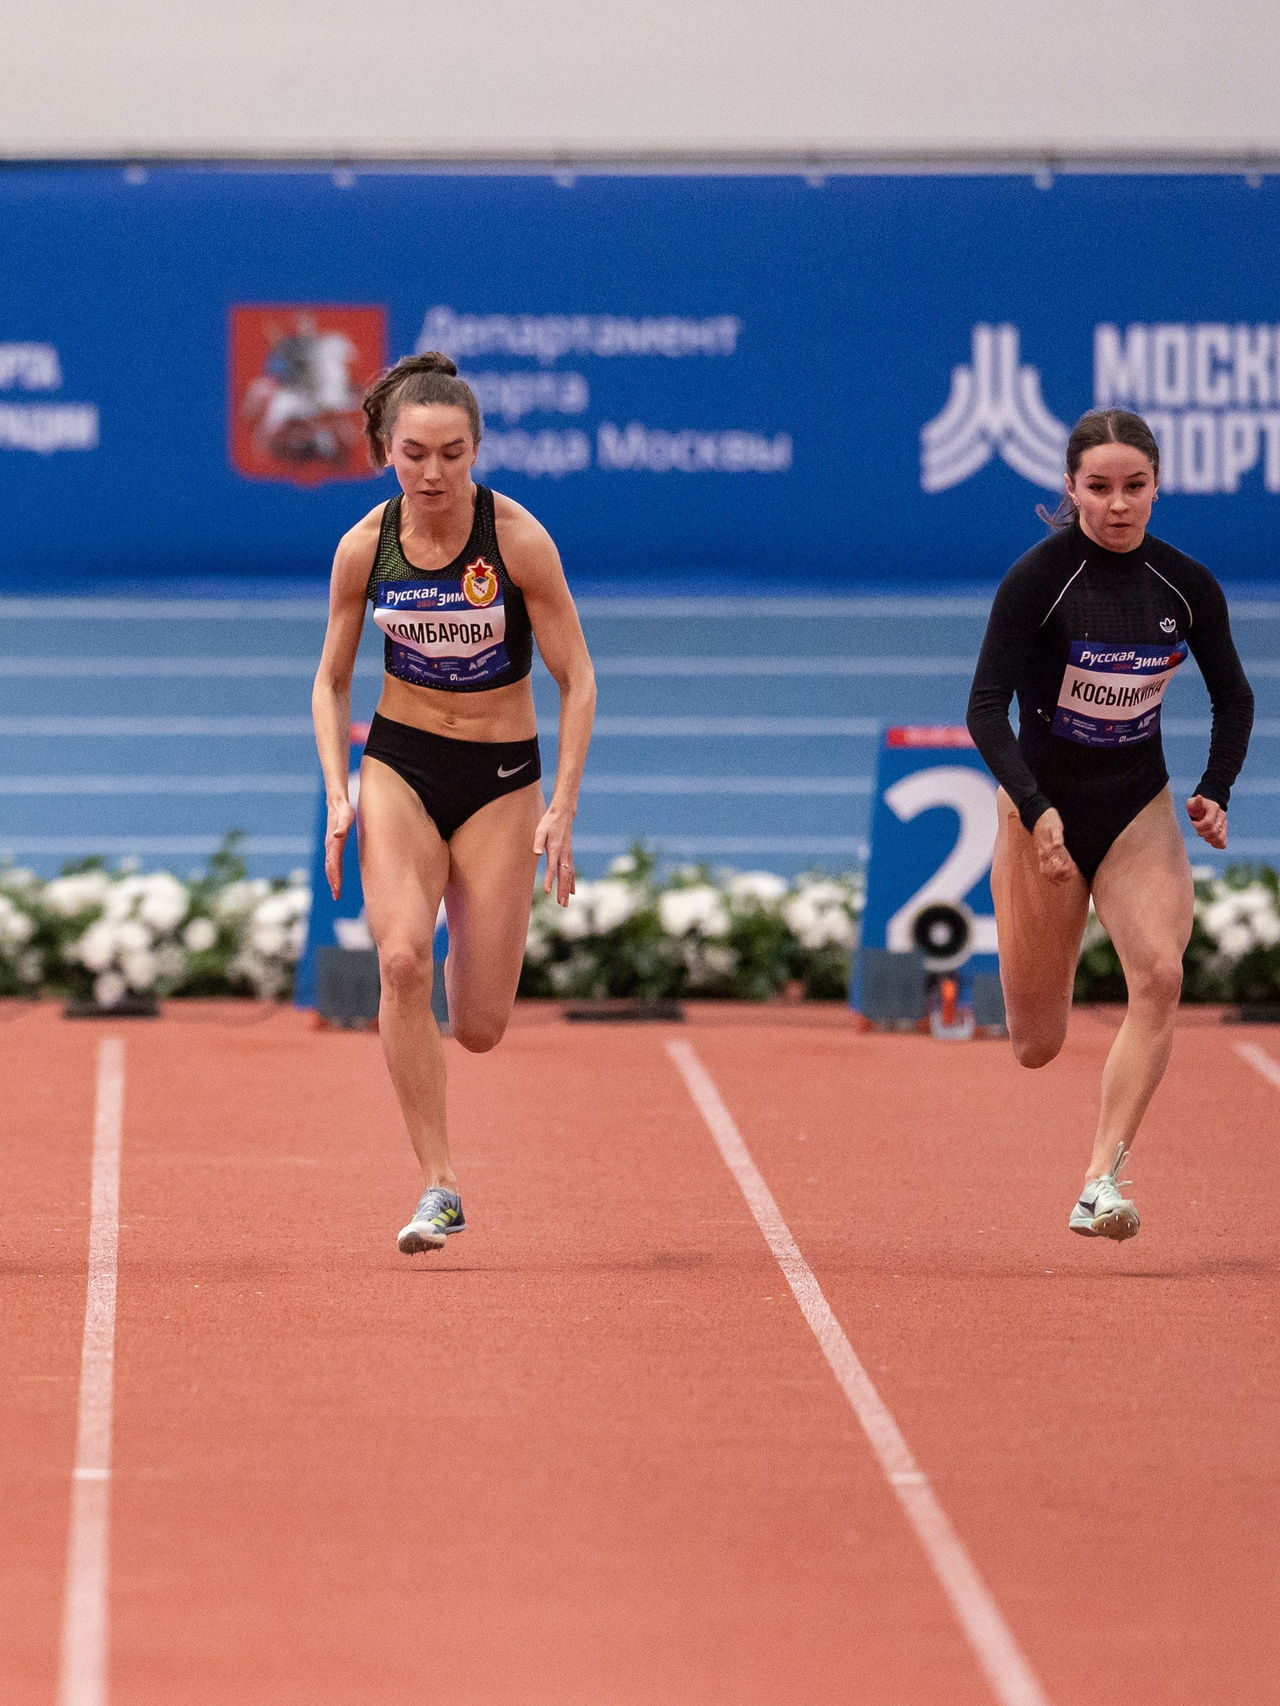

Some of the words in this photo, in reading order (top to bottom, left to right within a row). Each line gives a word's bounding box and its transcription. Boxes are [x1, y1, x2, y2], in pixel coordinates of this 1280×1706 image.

[1094, 324, 1280, 404] МОСК
[598, 423, 792, 472] Москвы
[1145, 414, 1280, 491] ПОРТ
[386, 587, 438, 605] Русская
[437, 592, 465, 606] Зим
[387, 623, 494, 645] КОМБАРОВА
[1080, 651, 1136, 666] Русская
[1132, 657, 1170, 670] Зима
[1070, 679, 1166, 707] КОСЫНКИНА
[885, 766, 999, 955] 2
